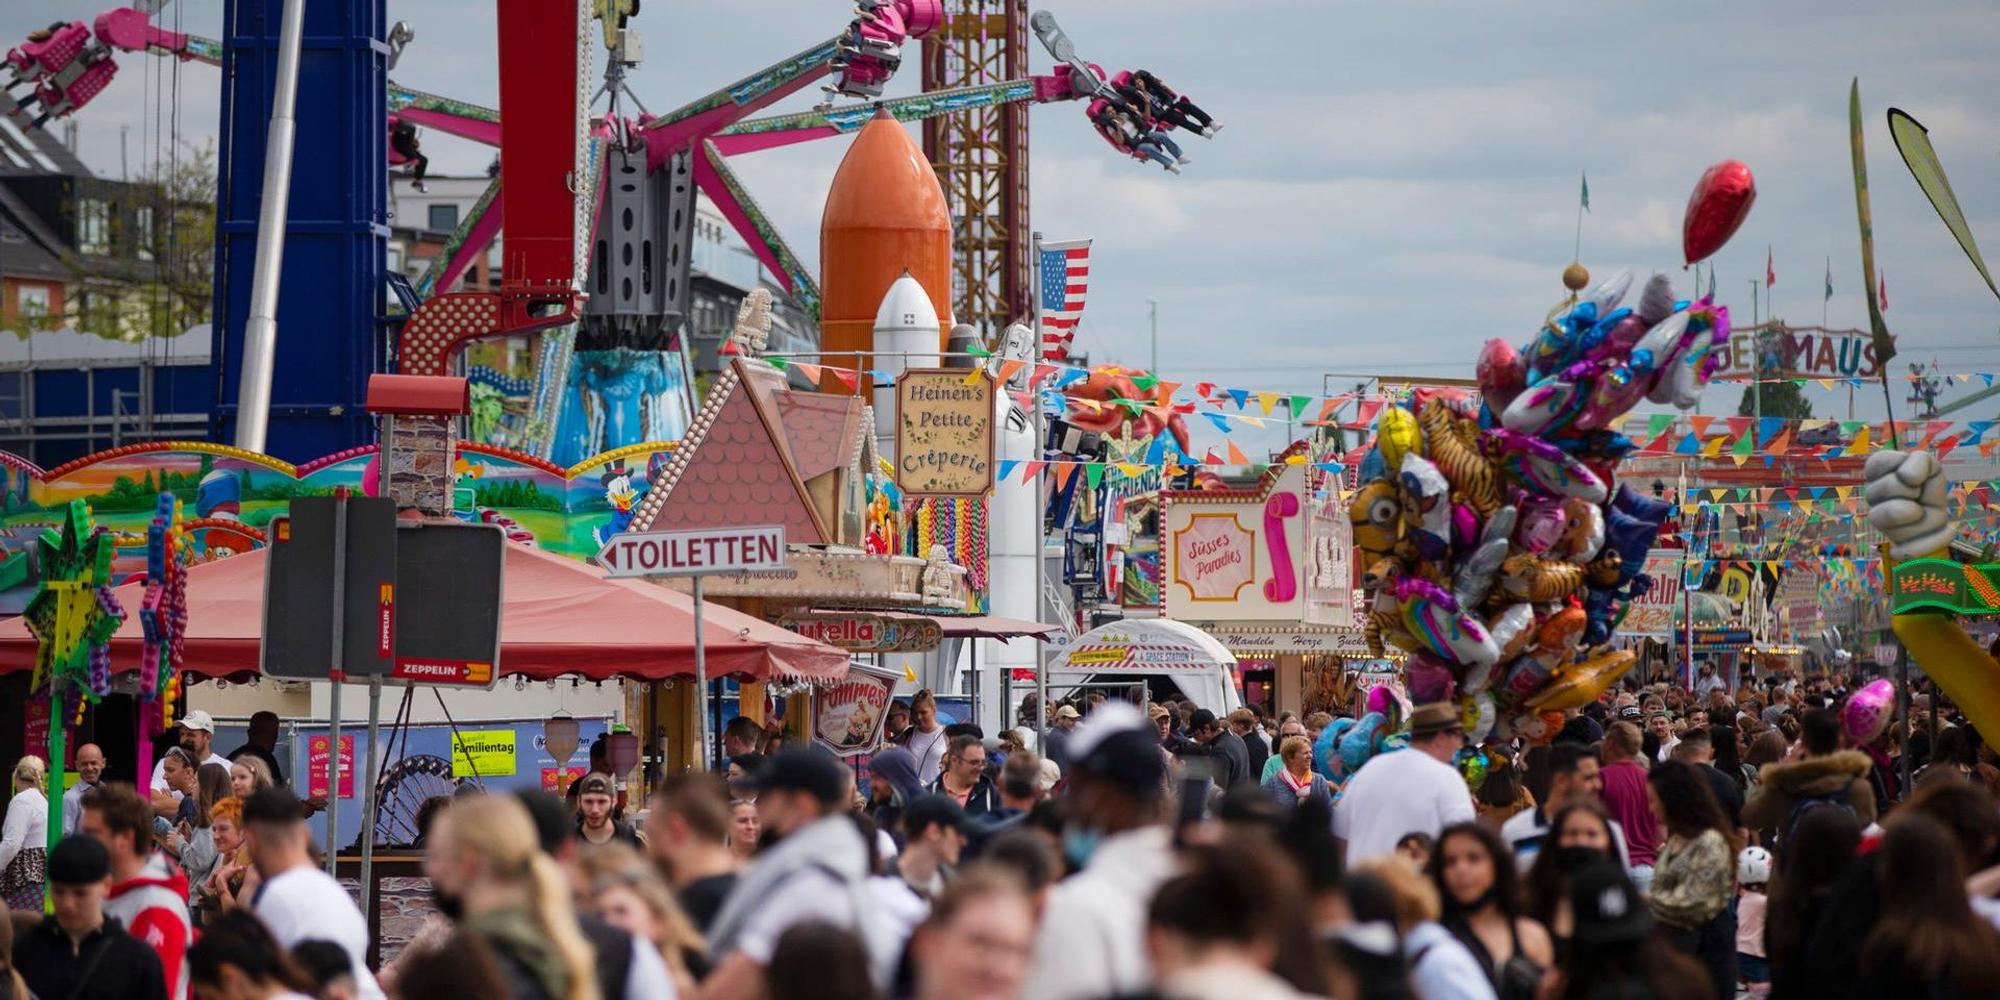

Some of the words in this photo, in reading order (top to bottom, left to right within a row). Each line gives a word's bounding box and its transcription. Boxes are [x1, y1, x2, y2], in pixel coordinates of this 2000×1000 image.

[1782, 334, 1878, 377] MAUS
[911, 385, 984, 401] Heinen's
[920, 411, 974, 428] Petite
[903, 449, 985, 473] Crêperie
[621, 535, 777, 570] TOILETTEN
[1189, 534, 1229, 559] Süsses
[1195, 549, 1242, 580] Paradies
[382, 610, 390, 650] ZEPPELIN
[1228, 635, 1275, 646] Mandeln
[1291, 636, 1323, 648] Herze
[1146, 651, 1165, 662] SPACE
[1167, 651, 1190, 662] STATION
[404, 664, 456, 676] ZEPPELIN
[453, 742, 514, 755] Familientag
